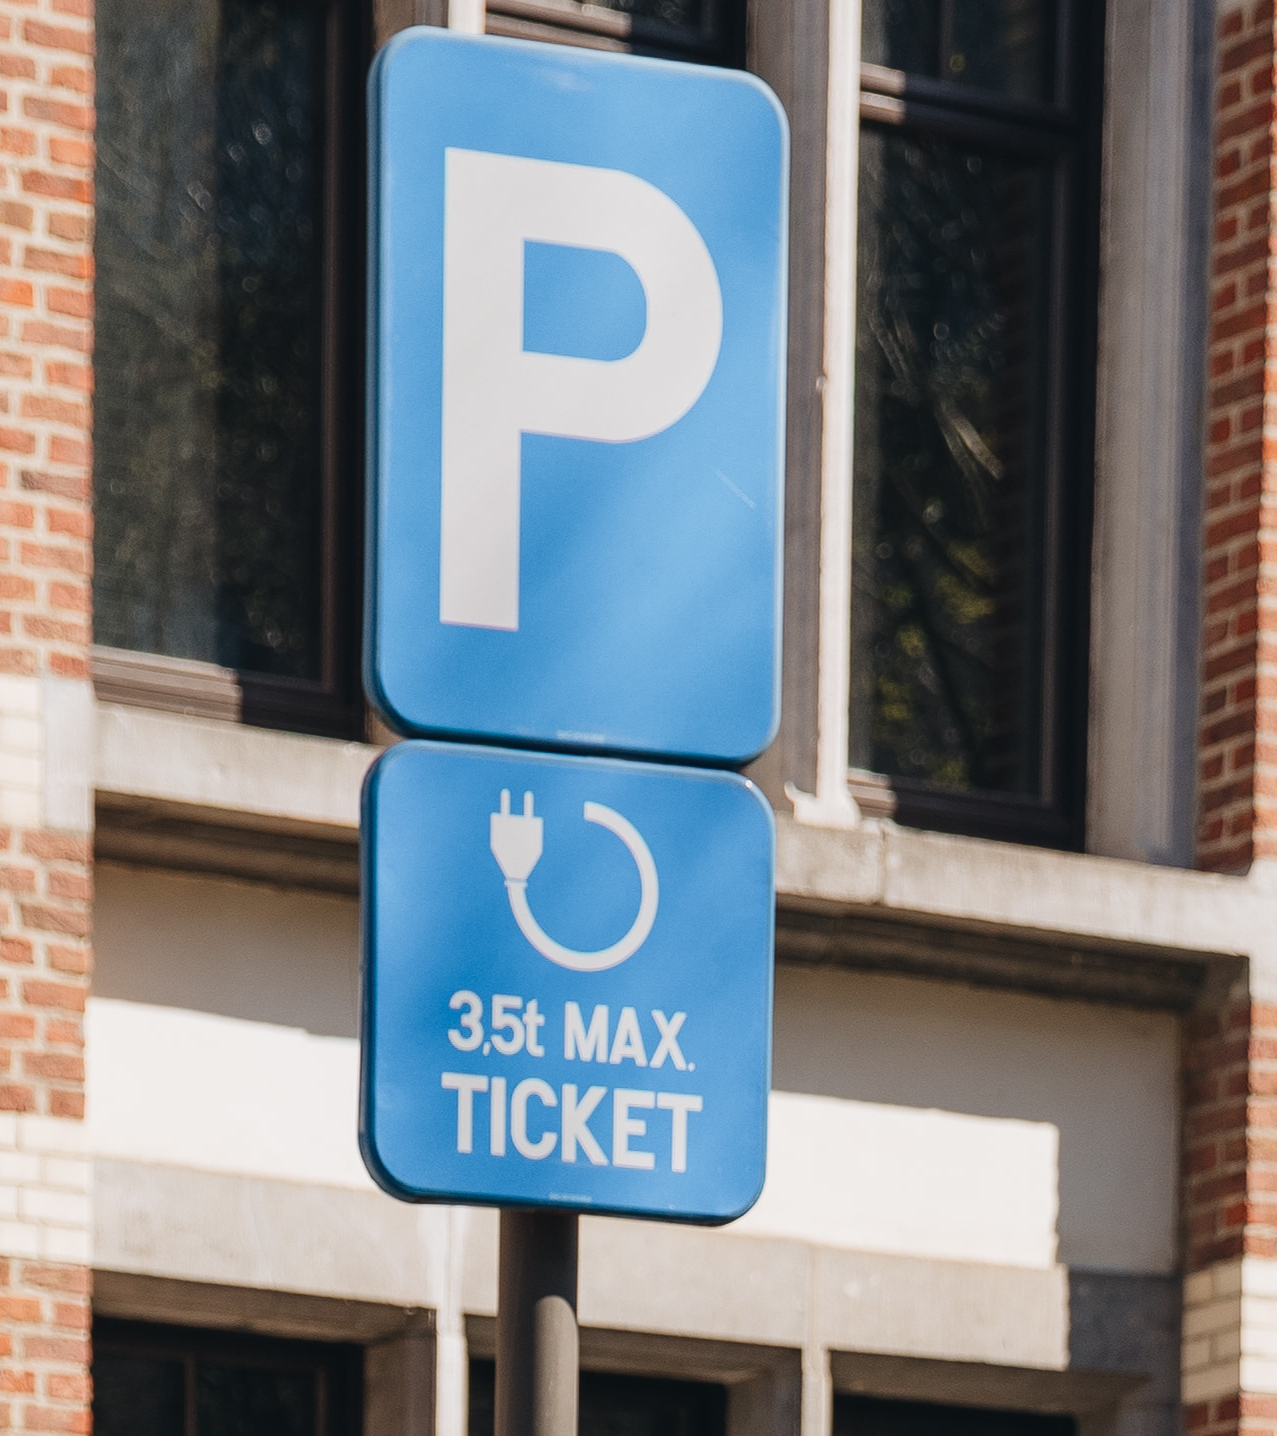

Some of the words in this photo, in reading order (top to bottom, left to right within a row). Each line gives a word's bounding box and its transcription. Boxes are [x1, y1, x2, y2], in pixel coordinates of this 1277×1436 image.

[440, 147, 723, 631] P
[564, 1001, 696, 1072] MAX.
[441, 1072, 703, 1173] TICKET
